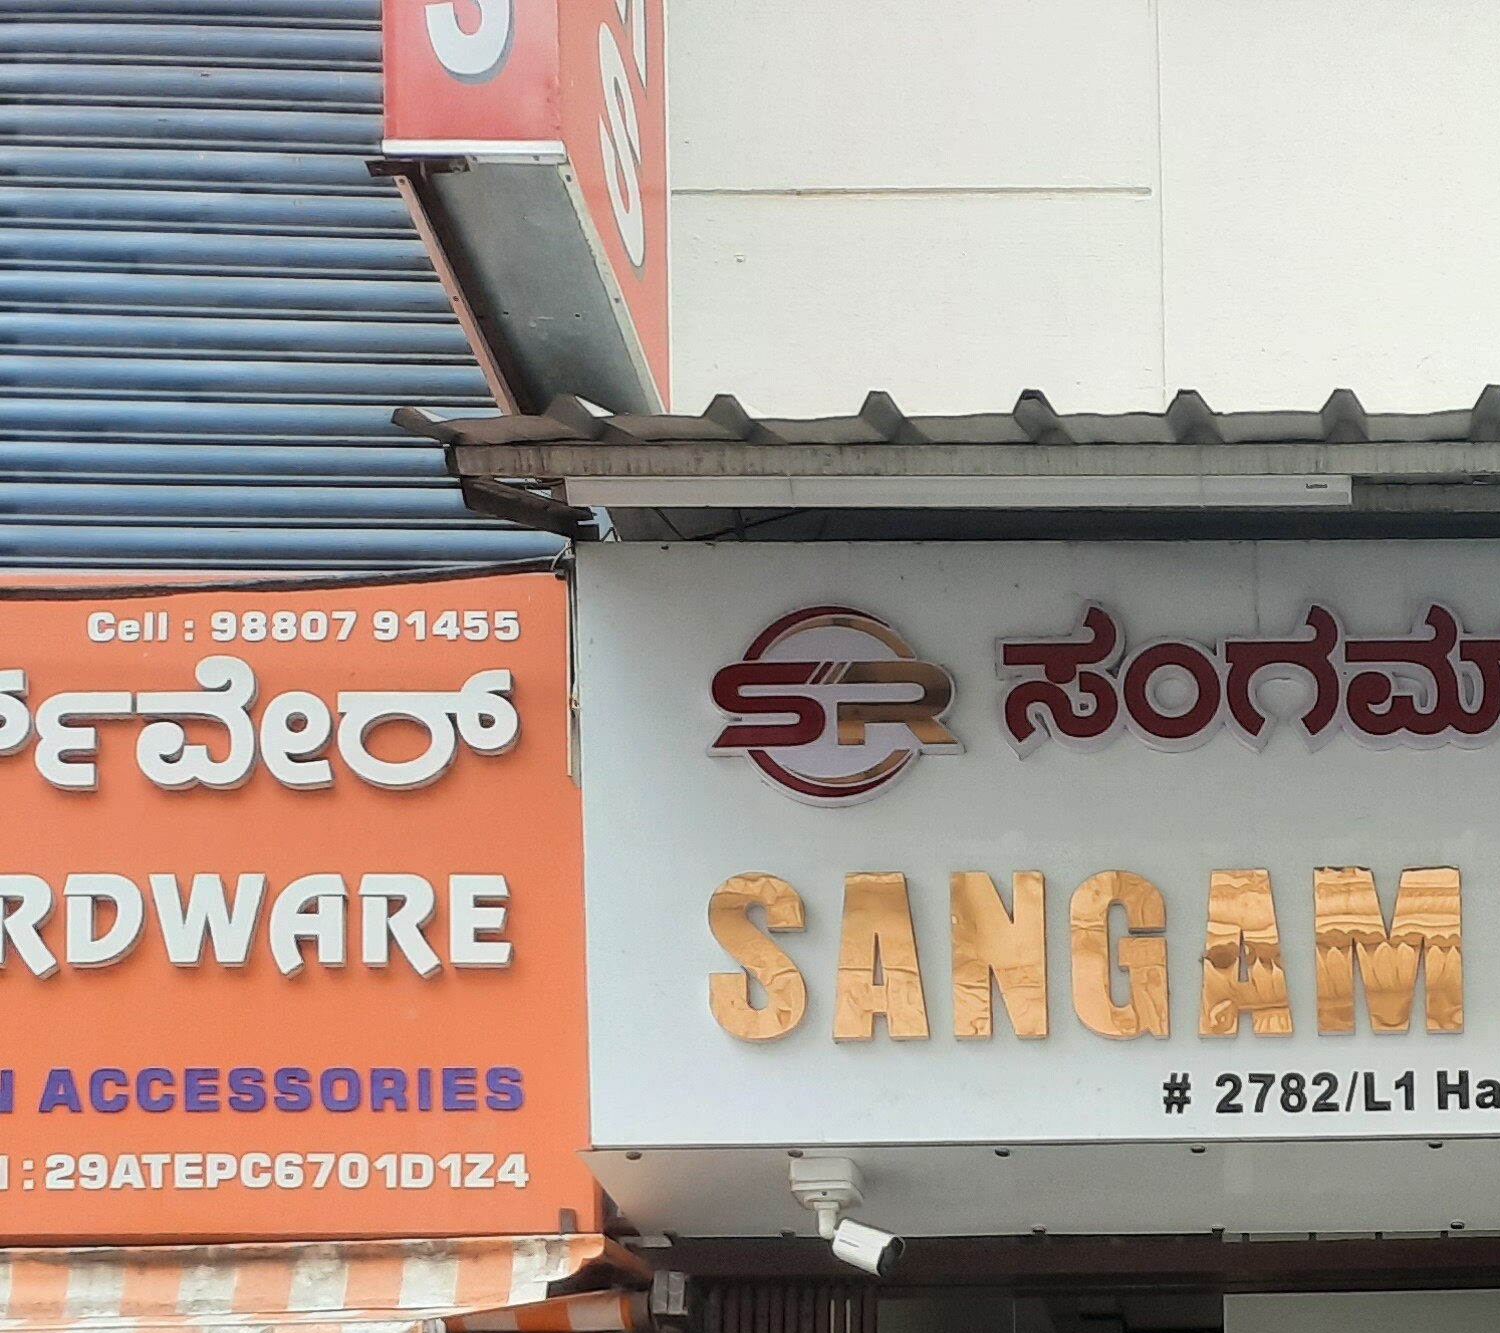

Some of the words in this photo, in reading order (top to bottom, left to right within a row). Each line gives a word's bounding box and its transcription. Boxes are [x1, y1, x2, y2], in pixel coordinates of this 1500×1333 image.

[87, 611, 168, 642] Cell
[210, 611, 357, 641] 98807
[373, 610, 521, 641] 91455
[707, 864, 1465, 1043] SANGAM
[38, 1066, 526, 1113] ACCESSORIES
[1214, 1068, 1416, 1114] 2782/L1
